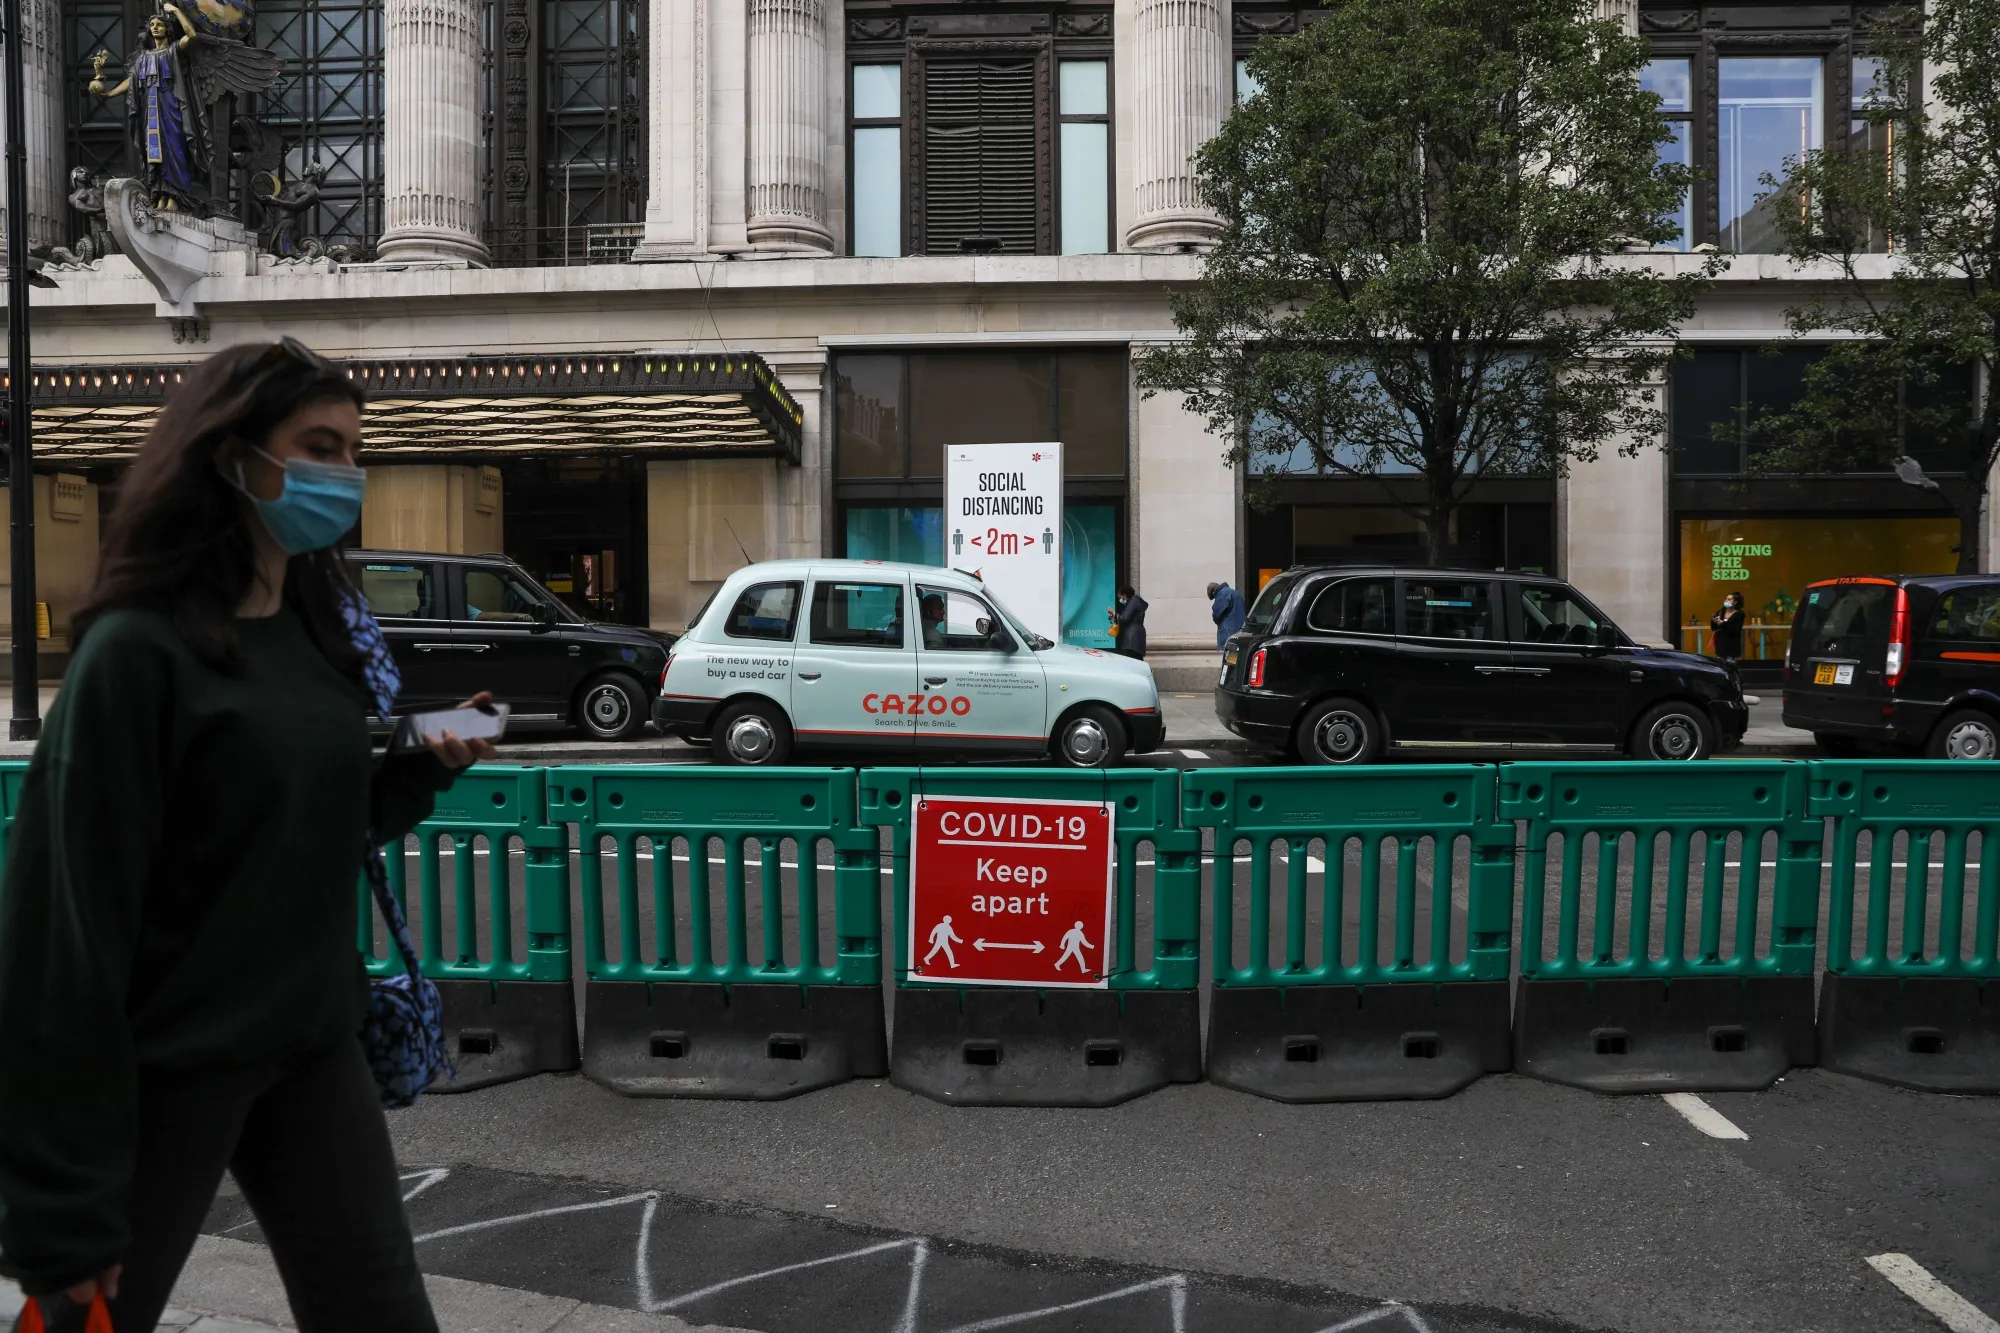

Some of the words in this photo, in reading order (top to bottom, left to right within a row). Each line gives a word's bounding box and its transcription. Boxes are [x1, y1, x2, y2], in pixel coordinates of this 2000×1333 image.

[979, 472, 1026, 492] SOCIAL
[962, 496, 1043, 516] DISTANCING
[1712, 544, 1772, 556] SOWING
[1712, 557, 1742, 568] THE
[1712, 569, 1750, 580] SEED
[1070, 630, 1104, 638] BIOSSANCE
[706, 655, 724, 664] The
[752, 660, 774, 668] way
[777, 658, 789, 666] to
[708, 668, 726, 680] buy
[740, 670, 764, 679] used
[862, 694, 971, 716] CAZOO
[875, 719, 906, 727] Search.
[940, 812, 1086, 840] COVID-19
[976, 858, 1048, 888] Keep
[971, 892, 1049, 917] apart
